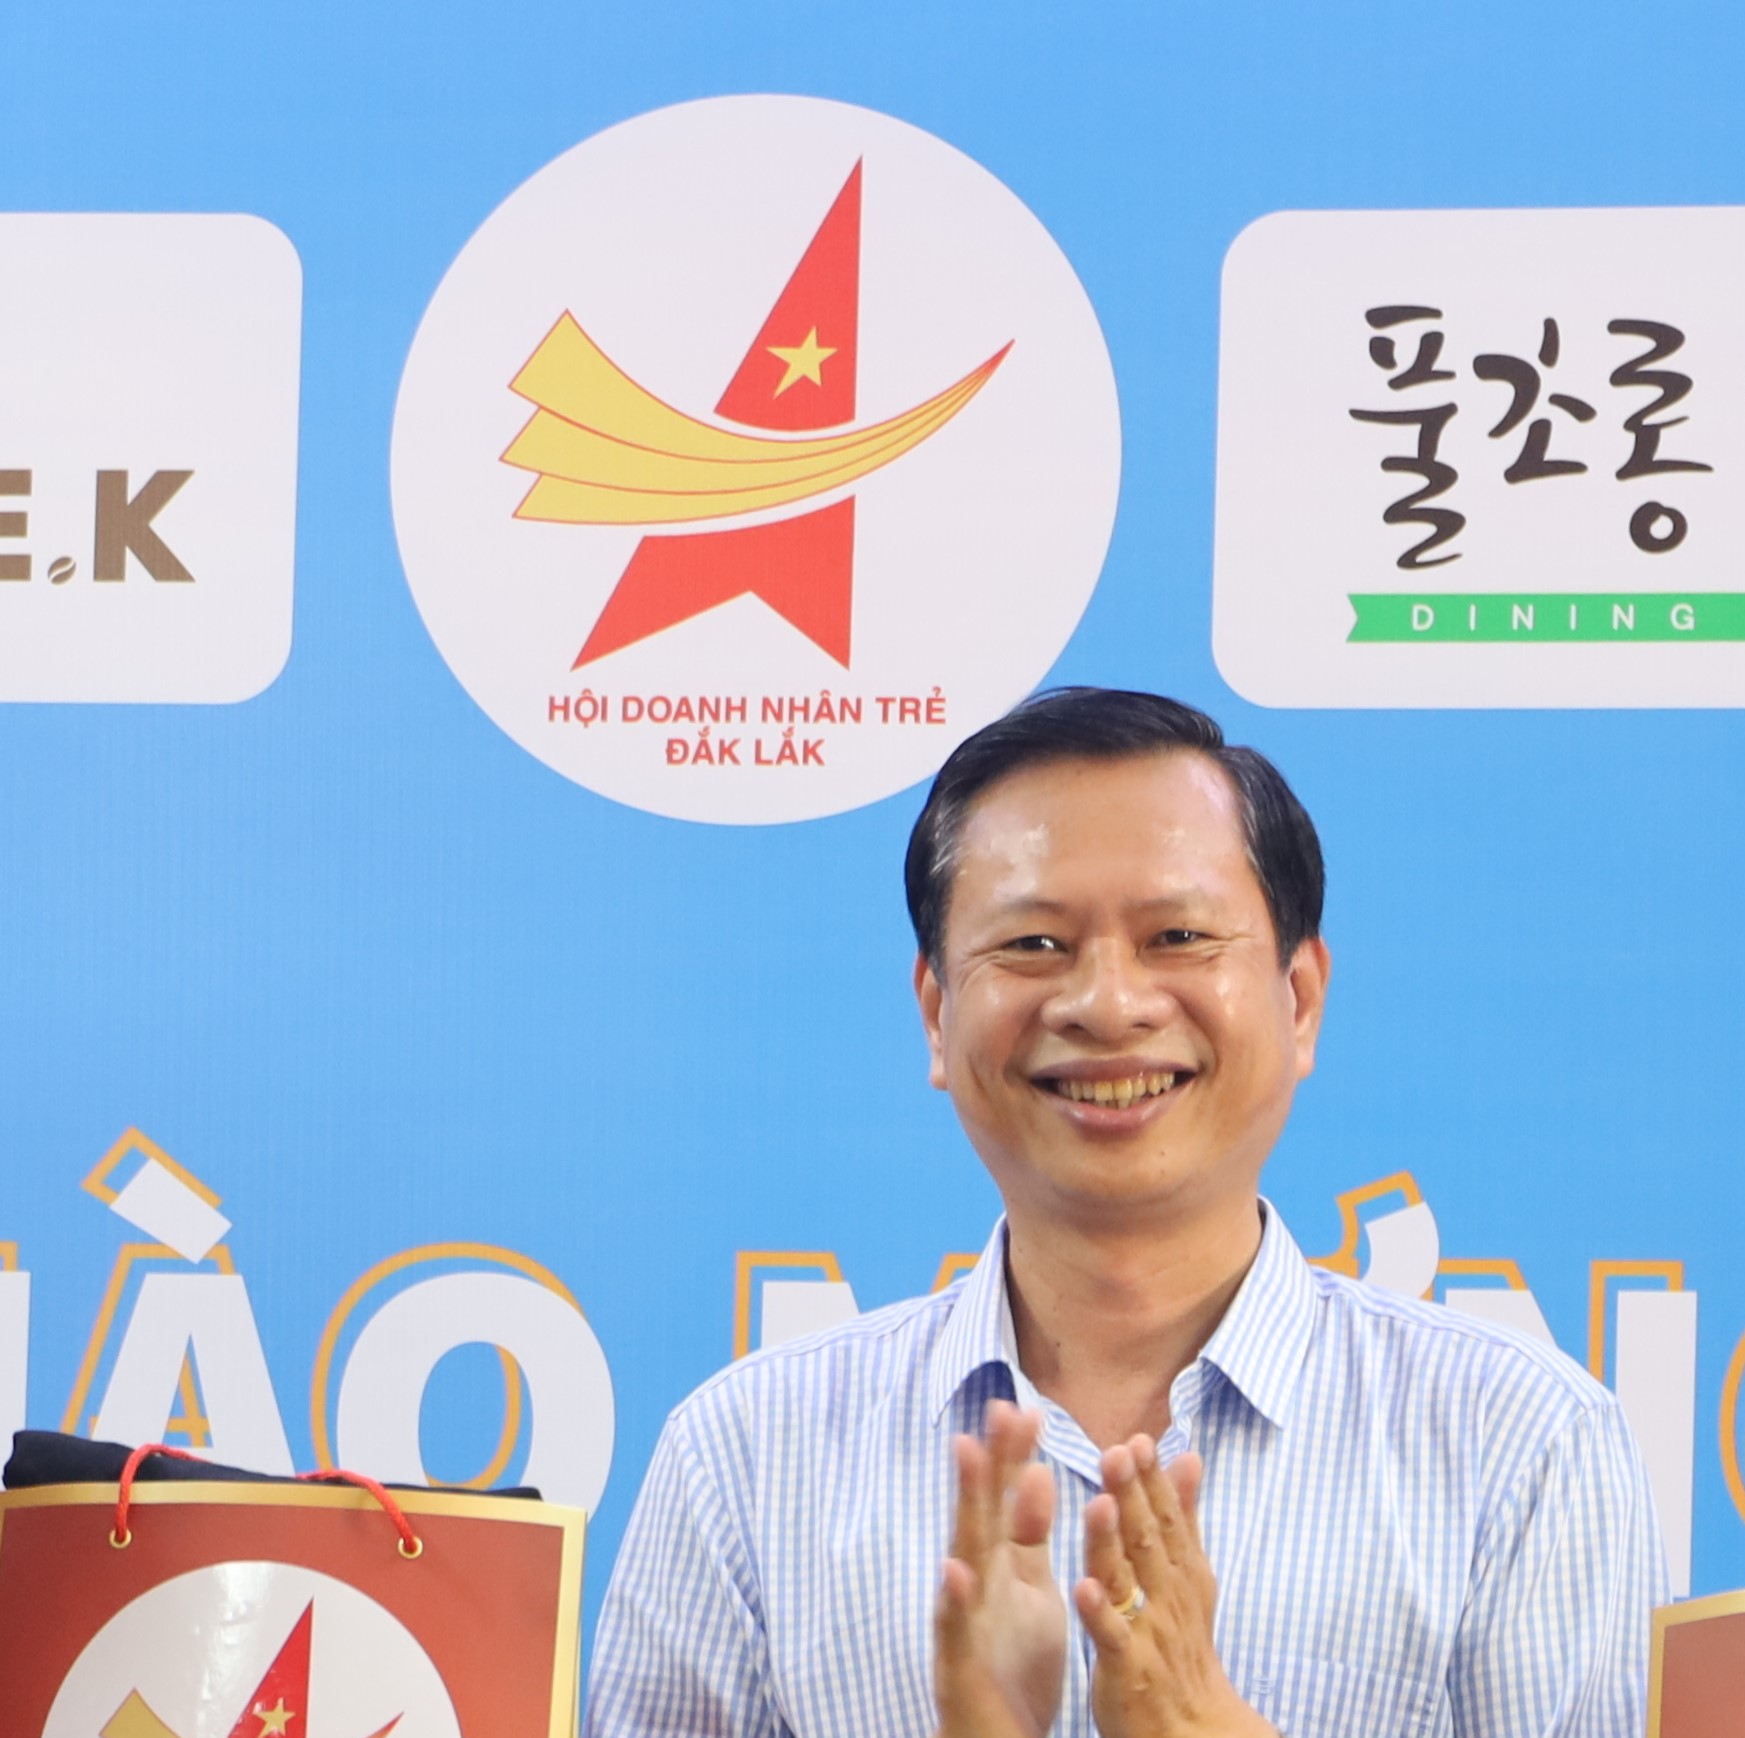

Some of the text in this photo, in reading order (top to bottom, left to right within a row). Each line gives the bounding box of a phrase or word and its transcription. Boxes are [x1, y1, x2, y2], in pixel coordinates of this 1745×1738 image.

[1411, 602, 1696, 631] DINING
[547, 686, 947, 730] HỘI DOANH NHÂN TRẺ
[665, 725, 826, 766] ĐẮK LẮK
